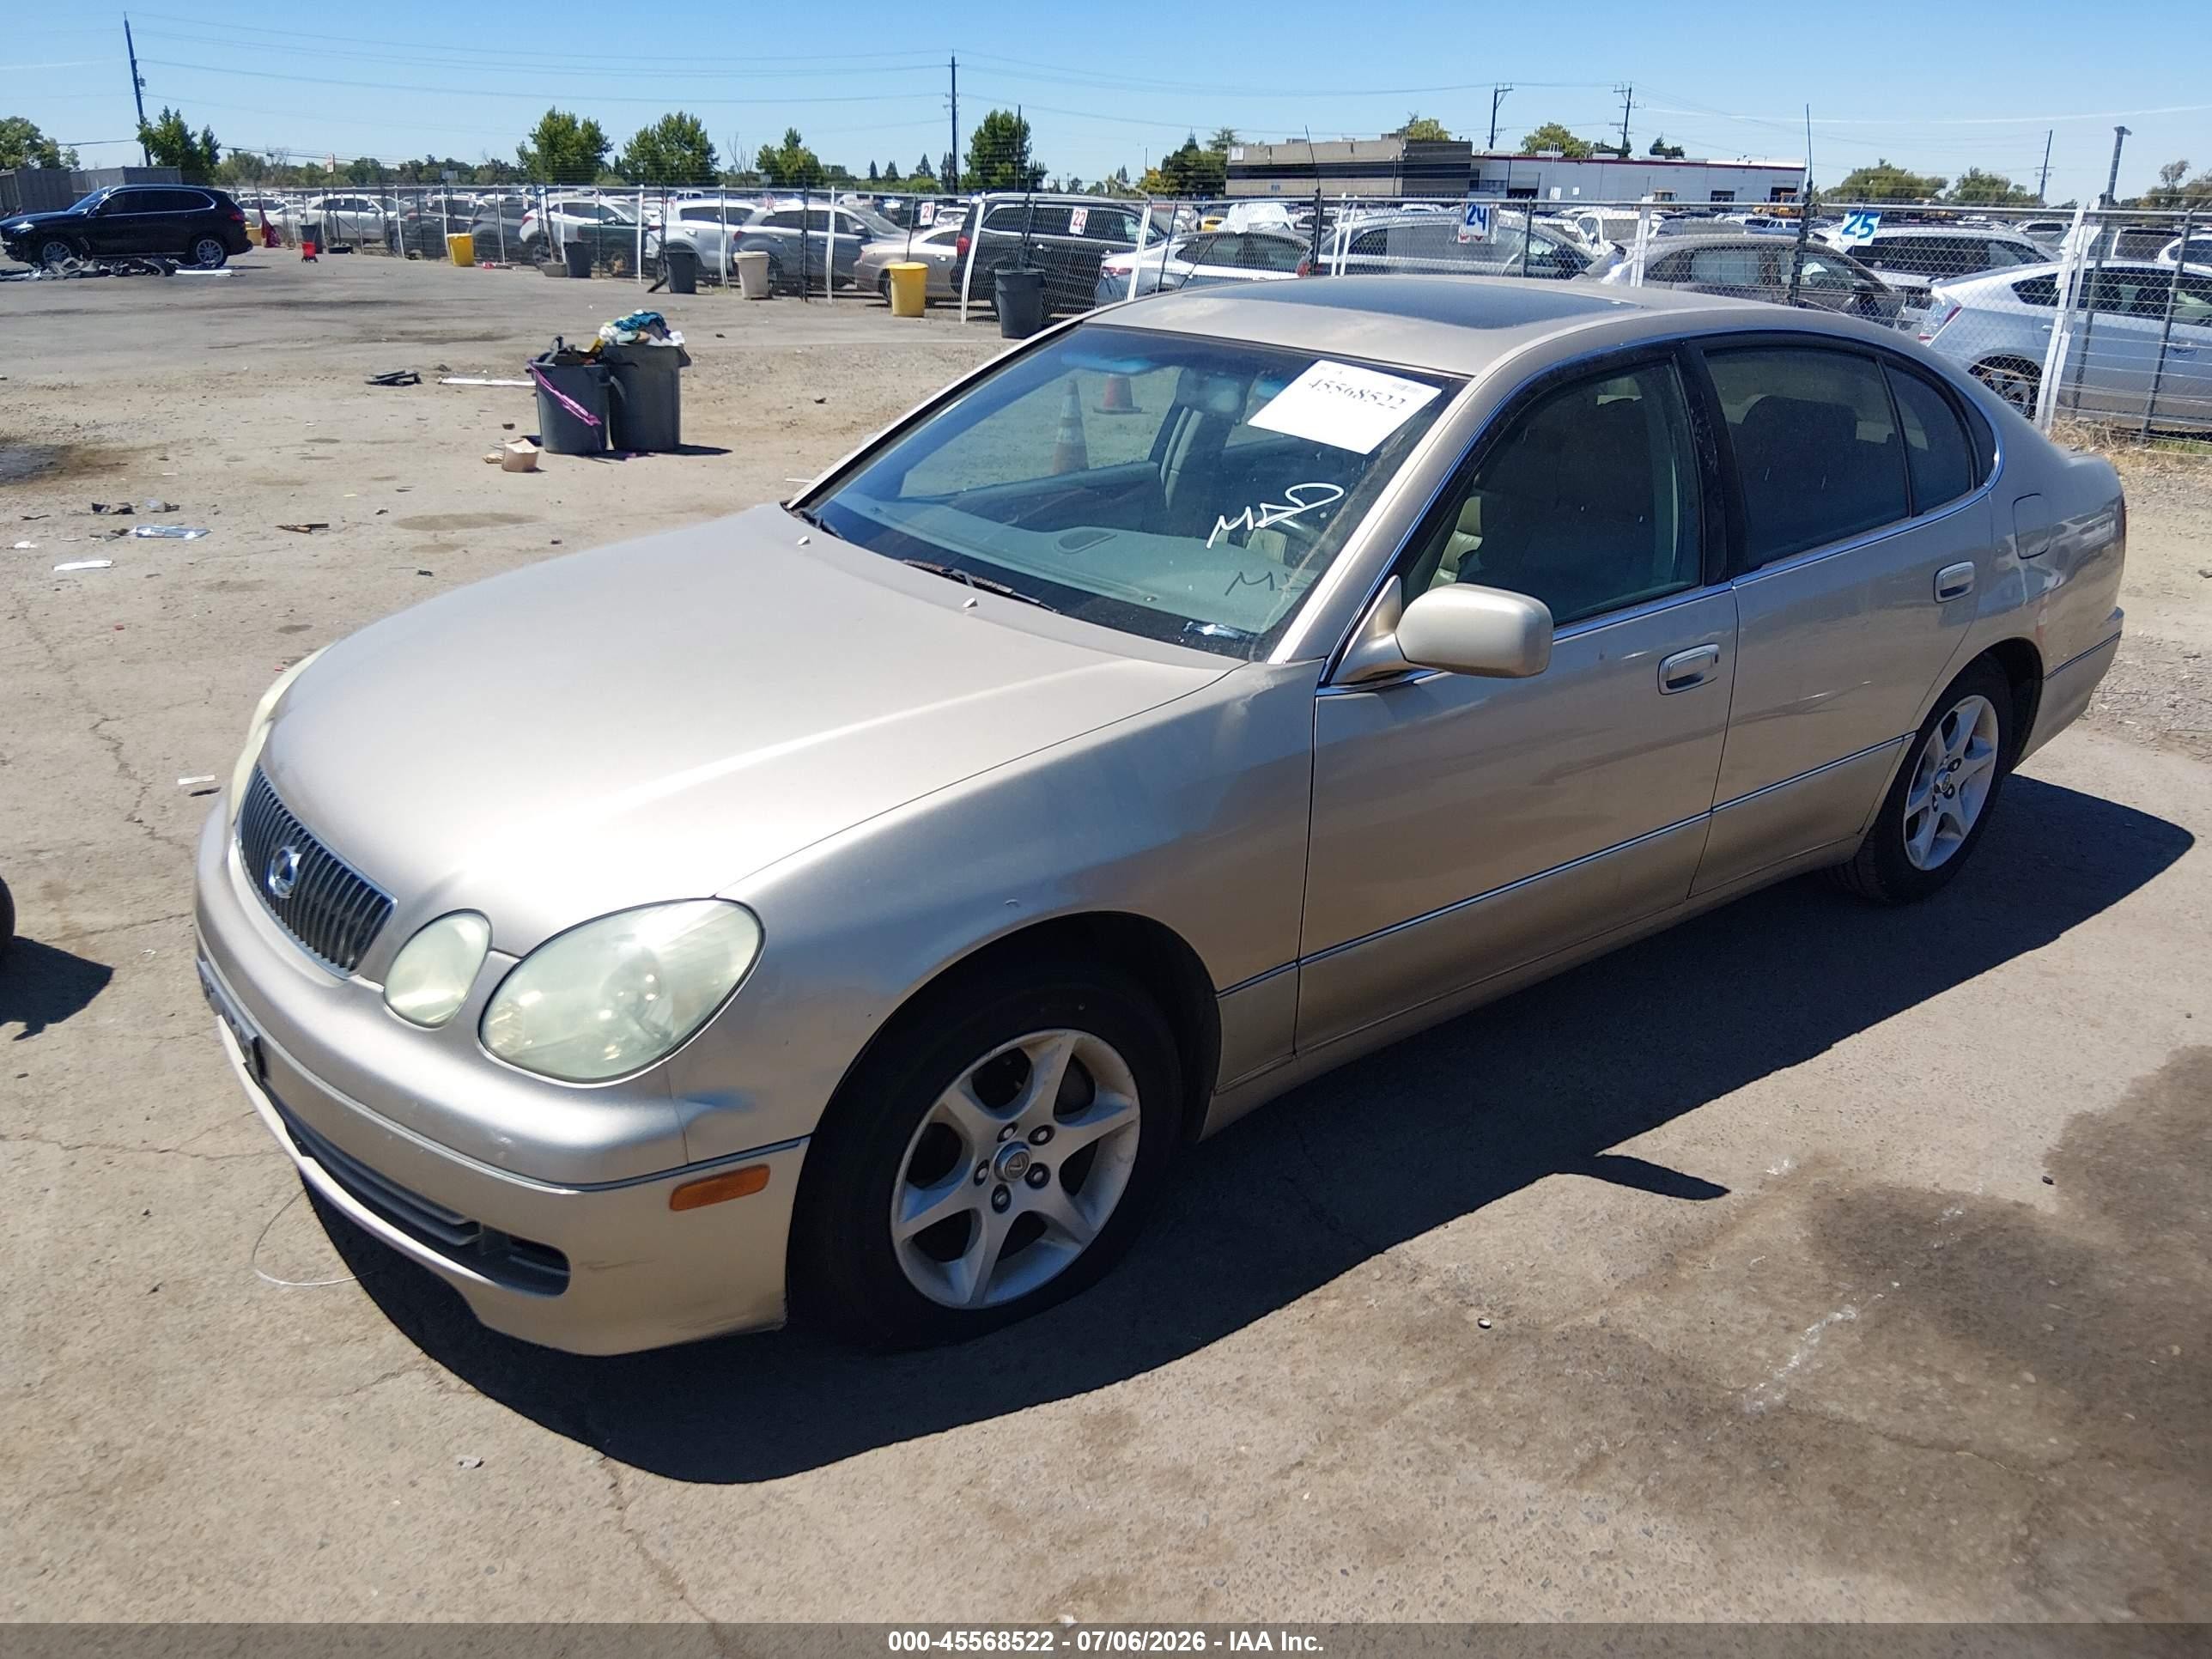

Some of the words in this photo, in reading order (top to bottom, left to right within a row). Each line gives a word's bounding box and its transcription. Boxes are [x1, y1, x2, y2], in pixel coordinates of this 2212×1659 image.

[921, 204, 933, 219] 21
[1073, 210, 1086, 227] 22
[1466, 203, 1487, 231] 24
[1841, 210, 1881, 240] 25
